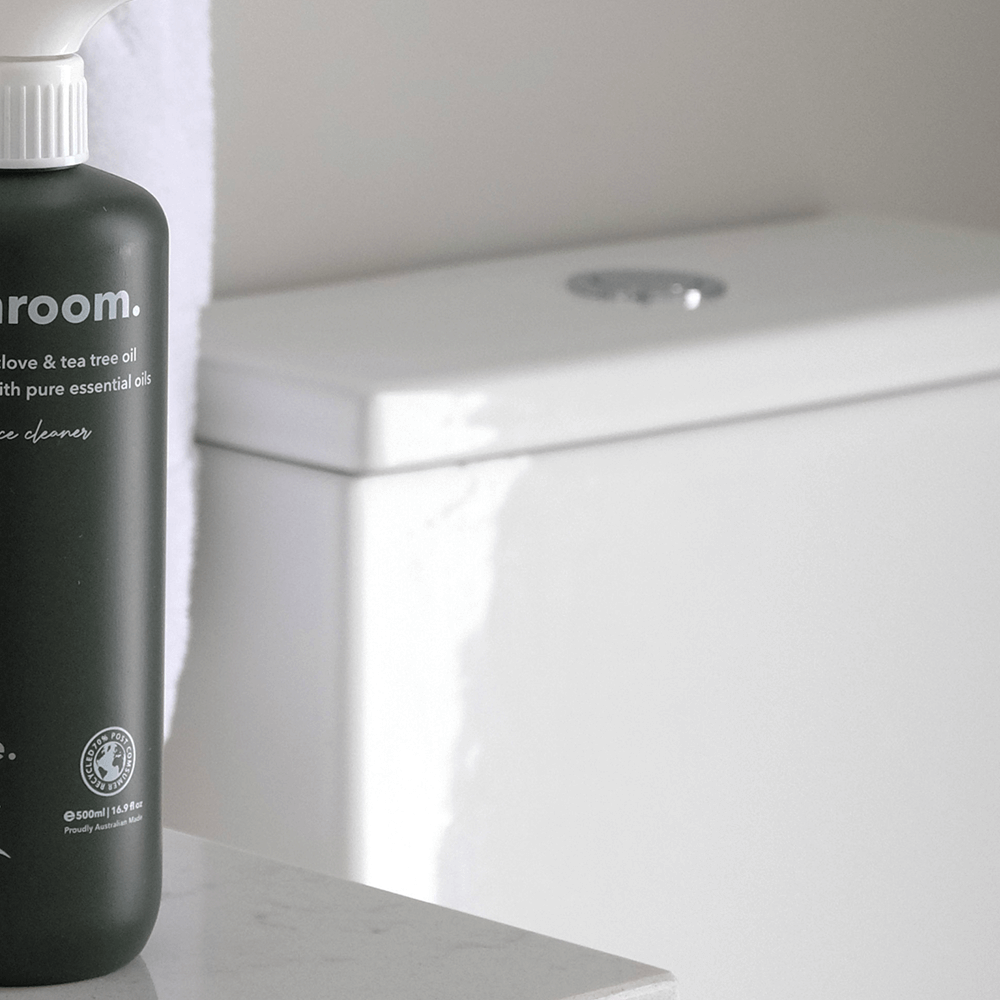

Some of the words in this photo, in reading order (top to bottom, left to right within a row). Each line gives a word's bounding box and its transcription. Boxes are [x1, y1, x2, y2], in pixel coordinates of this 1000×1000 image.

[43, 354, 57, 370] &
[60, 354, 86, 369] tea
[89, 352, 119, 366] tree
[122, 346, 137, 363] oil
[26, 383, 65, 400] pure
[69, 376, 132, 395] essential
[134, 370, 152, 387] oils
[24, 419, 92, 443] cleaner
[111, 732, 129, 745] POST
[85, 750, 106, 791] RECYCLED
[111, 803, 129, 815] 16.9
[129, 801, 135, 811] fl
[135, 801, 143, 809] oz
[64, 824, 93, 834] Proudly
[94, 820, 127, 830] Australian
[128, 814, 143, 824] Made
